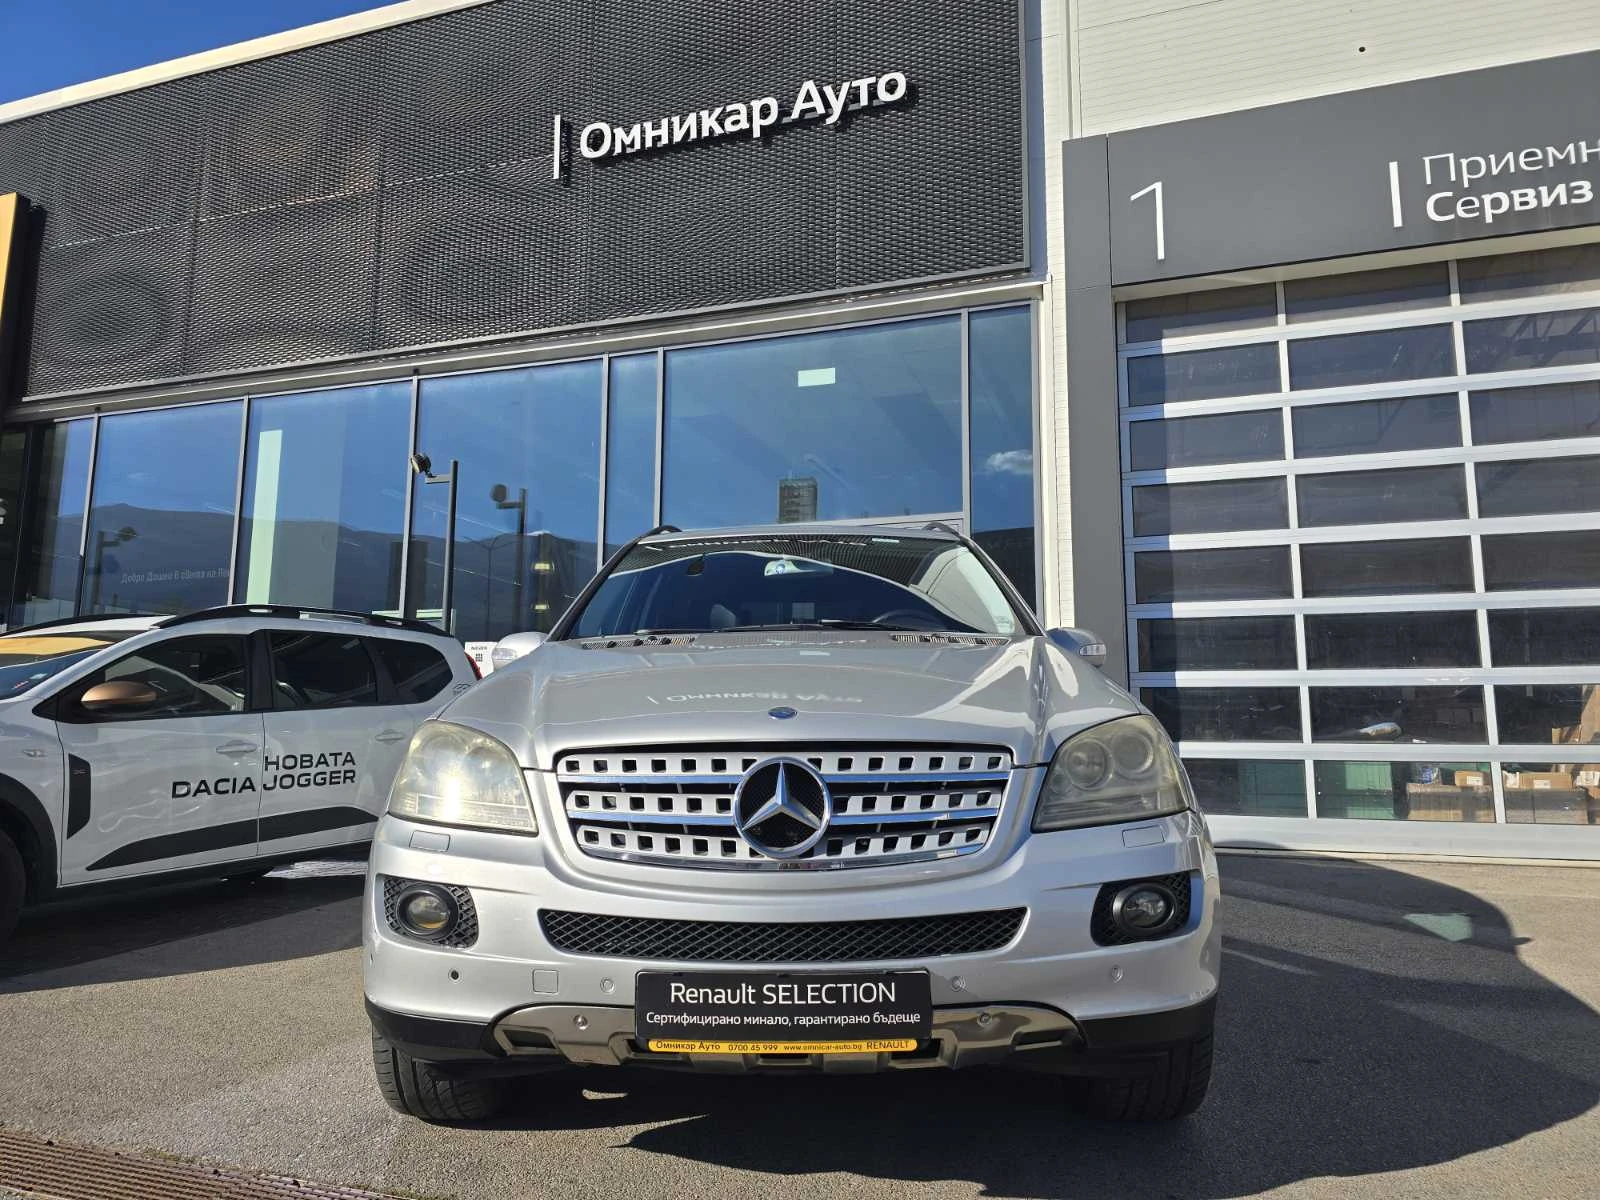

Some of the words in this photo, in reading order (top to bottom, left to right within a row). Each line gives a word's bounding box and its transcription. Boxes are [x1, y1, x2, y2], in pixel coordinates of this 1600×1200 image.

[579, 96, 779, 159] Омникар
[790, 71, 908, 126] Ауто
[1422, 139, 1600, 188] Приемн
[1425, 178, 1594, 224] Сервиз
[1129, 180, 1166, 261] 1
[264, 751, 356, 771] НОВАТА
[171, 776, 257, 799] DACIA
[262, 769, 356, 791] JOGGER
[669, 982, 756, 1005] Renault
[762, 981, 896, 1005] SELECTION
[646, 1011, 741, 1027] Сертифицирано
[743, 1016, 792, 1027] минало,
[794, 1014, 871, 1028] гарантирано
[872, 1011, 921, 1025] бъдеще
[655, 1040, 696, 1052] Омникар
[698, 1040, 721, 1052] Ауто
[763, 1043, 778, 1052] 999
[866, 1040, 909, 1051] RENAULT
